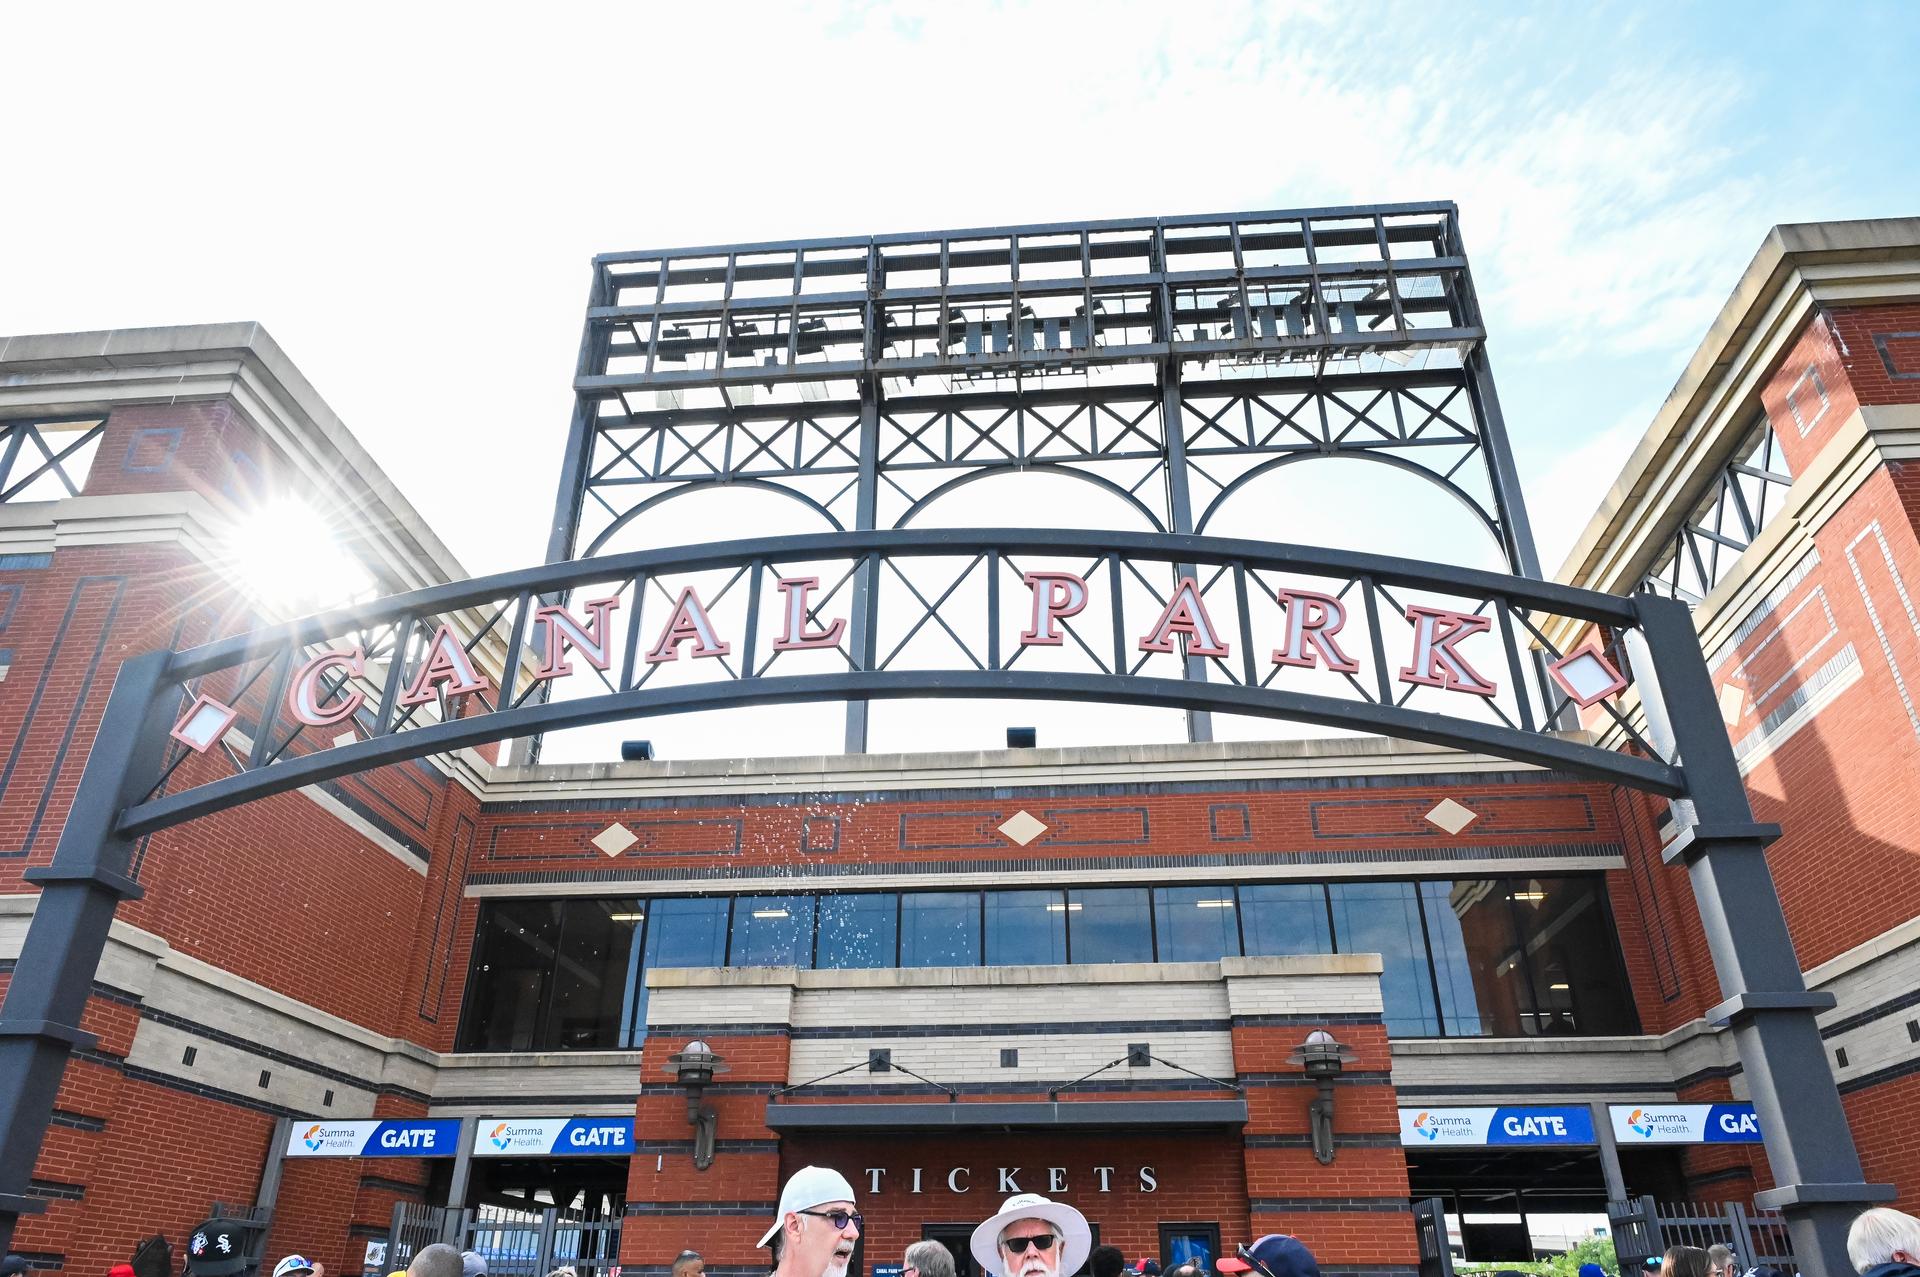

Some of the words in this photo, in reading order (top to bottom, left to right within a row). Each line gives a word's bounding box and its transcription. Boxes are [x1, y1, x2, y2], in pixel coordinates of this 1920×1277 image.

[288, 576, 847, 726] CANAL
[1020, 571, 1497, 697] PARK
[1429, 1116, 1471, 1126] Summa
[1643, 1113, 1687, 1123] Summa
[1719, 1113, 1758, 1133] GA
[1503, 1116, 1567, 1136] GATE
[1657, 1125, 1690, 1134] Health
[319, 1128, 355, 1138] Summa
[506, 1127, 543, 1136] Summa
[570, 1127, 626, 1146] GATE
[1442, 1128, 1473, 1137] Health
[381, 1129, 436, 1148] GATE
[513, 1138, 541, 1146] Health
[325, 1140, 353, 1148] Health
[865, 1166, 1157, 1193] TICKETS
